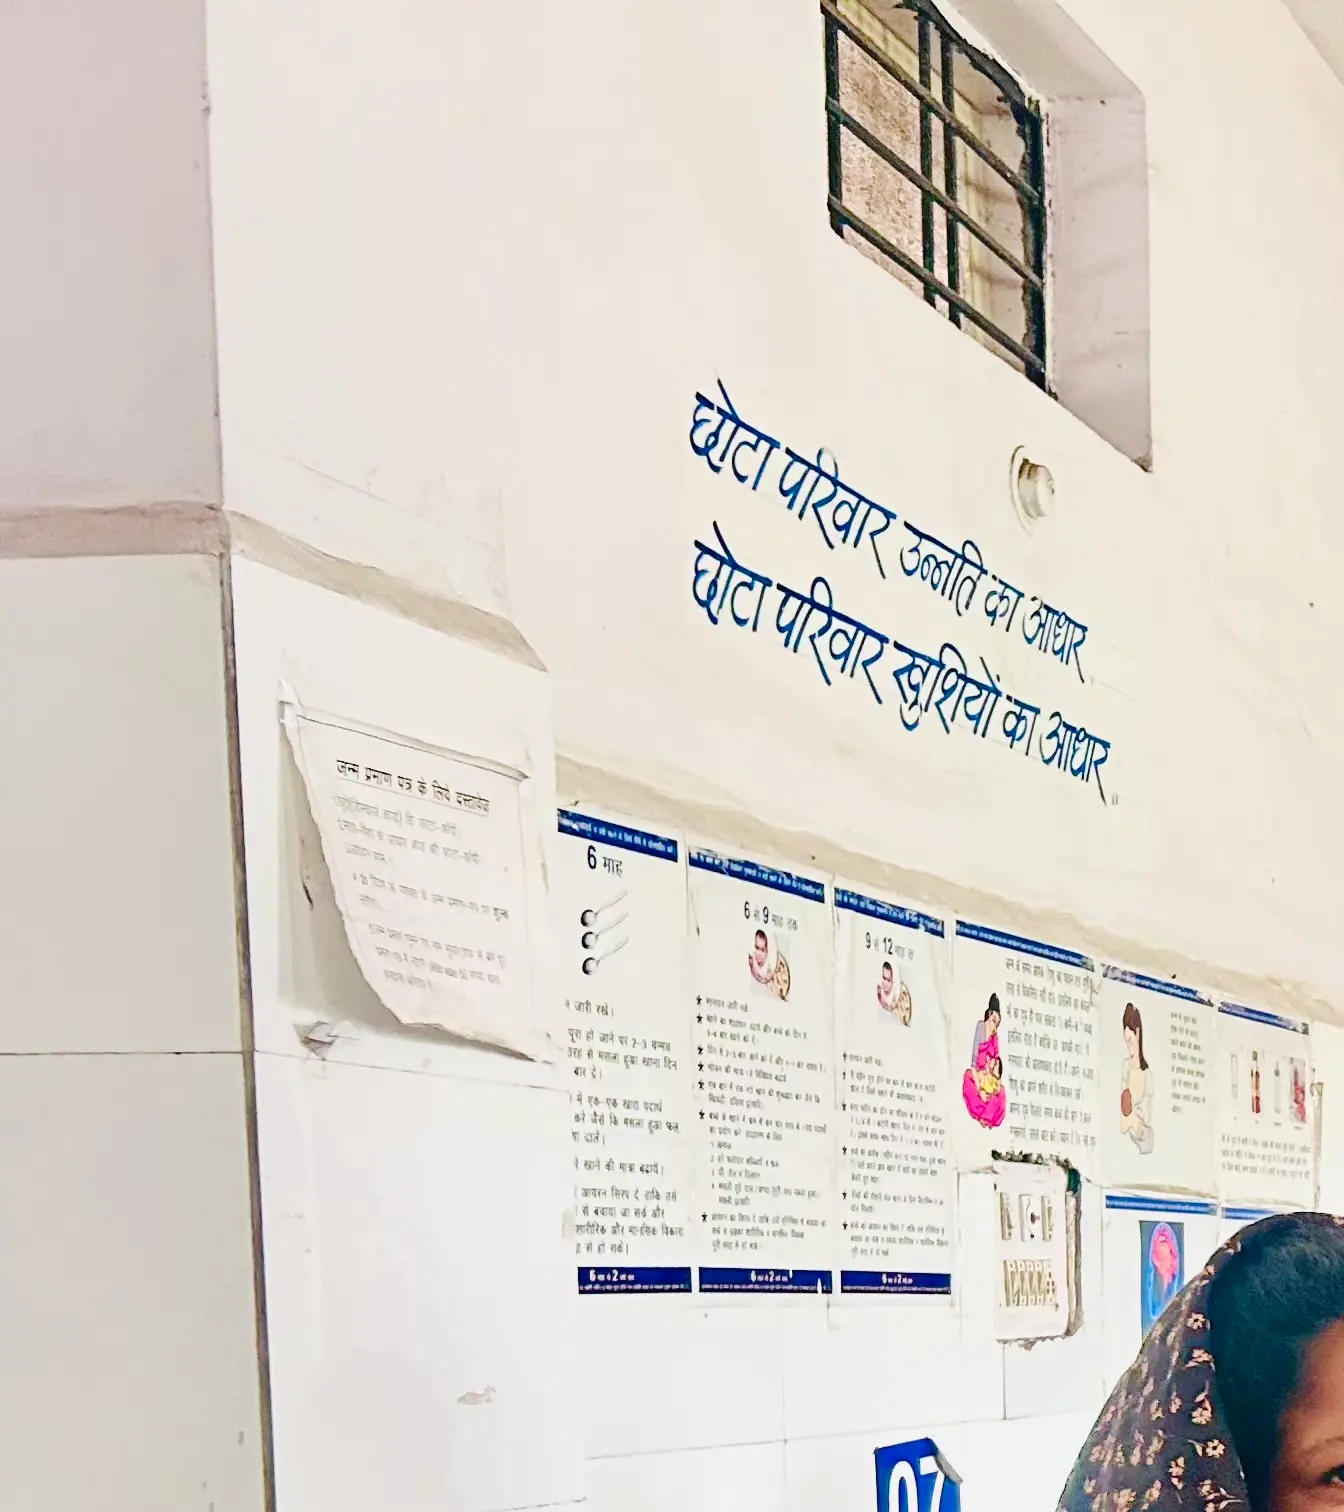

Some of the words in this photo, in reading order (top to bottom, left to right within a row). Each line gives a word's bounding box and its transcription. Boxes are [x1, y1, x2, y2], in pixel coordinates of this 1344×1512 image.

[689, 378, 781, 490] छोटा
[779, 448, 897, 580] परिवार
[900, 520, 988, 617] उन्नति
[985, 574, 1025, 632] का
[692, 520, 773, 632] छोटा
[776, 577, 890, 704] परिवार
[1003, 694, 1041, 756] का
[587, 845, 597, 869] 6
[602, 856, 622, 877] माह
[744, 901, 750, 919] 6
[762, 906, 769, 924] 9
[865, 932, 871, 949] 9
[882, 936, 893, 955] 12
